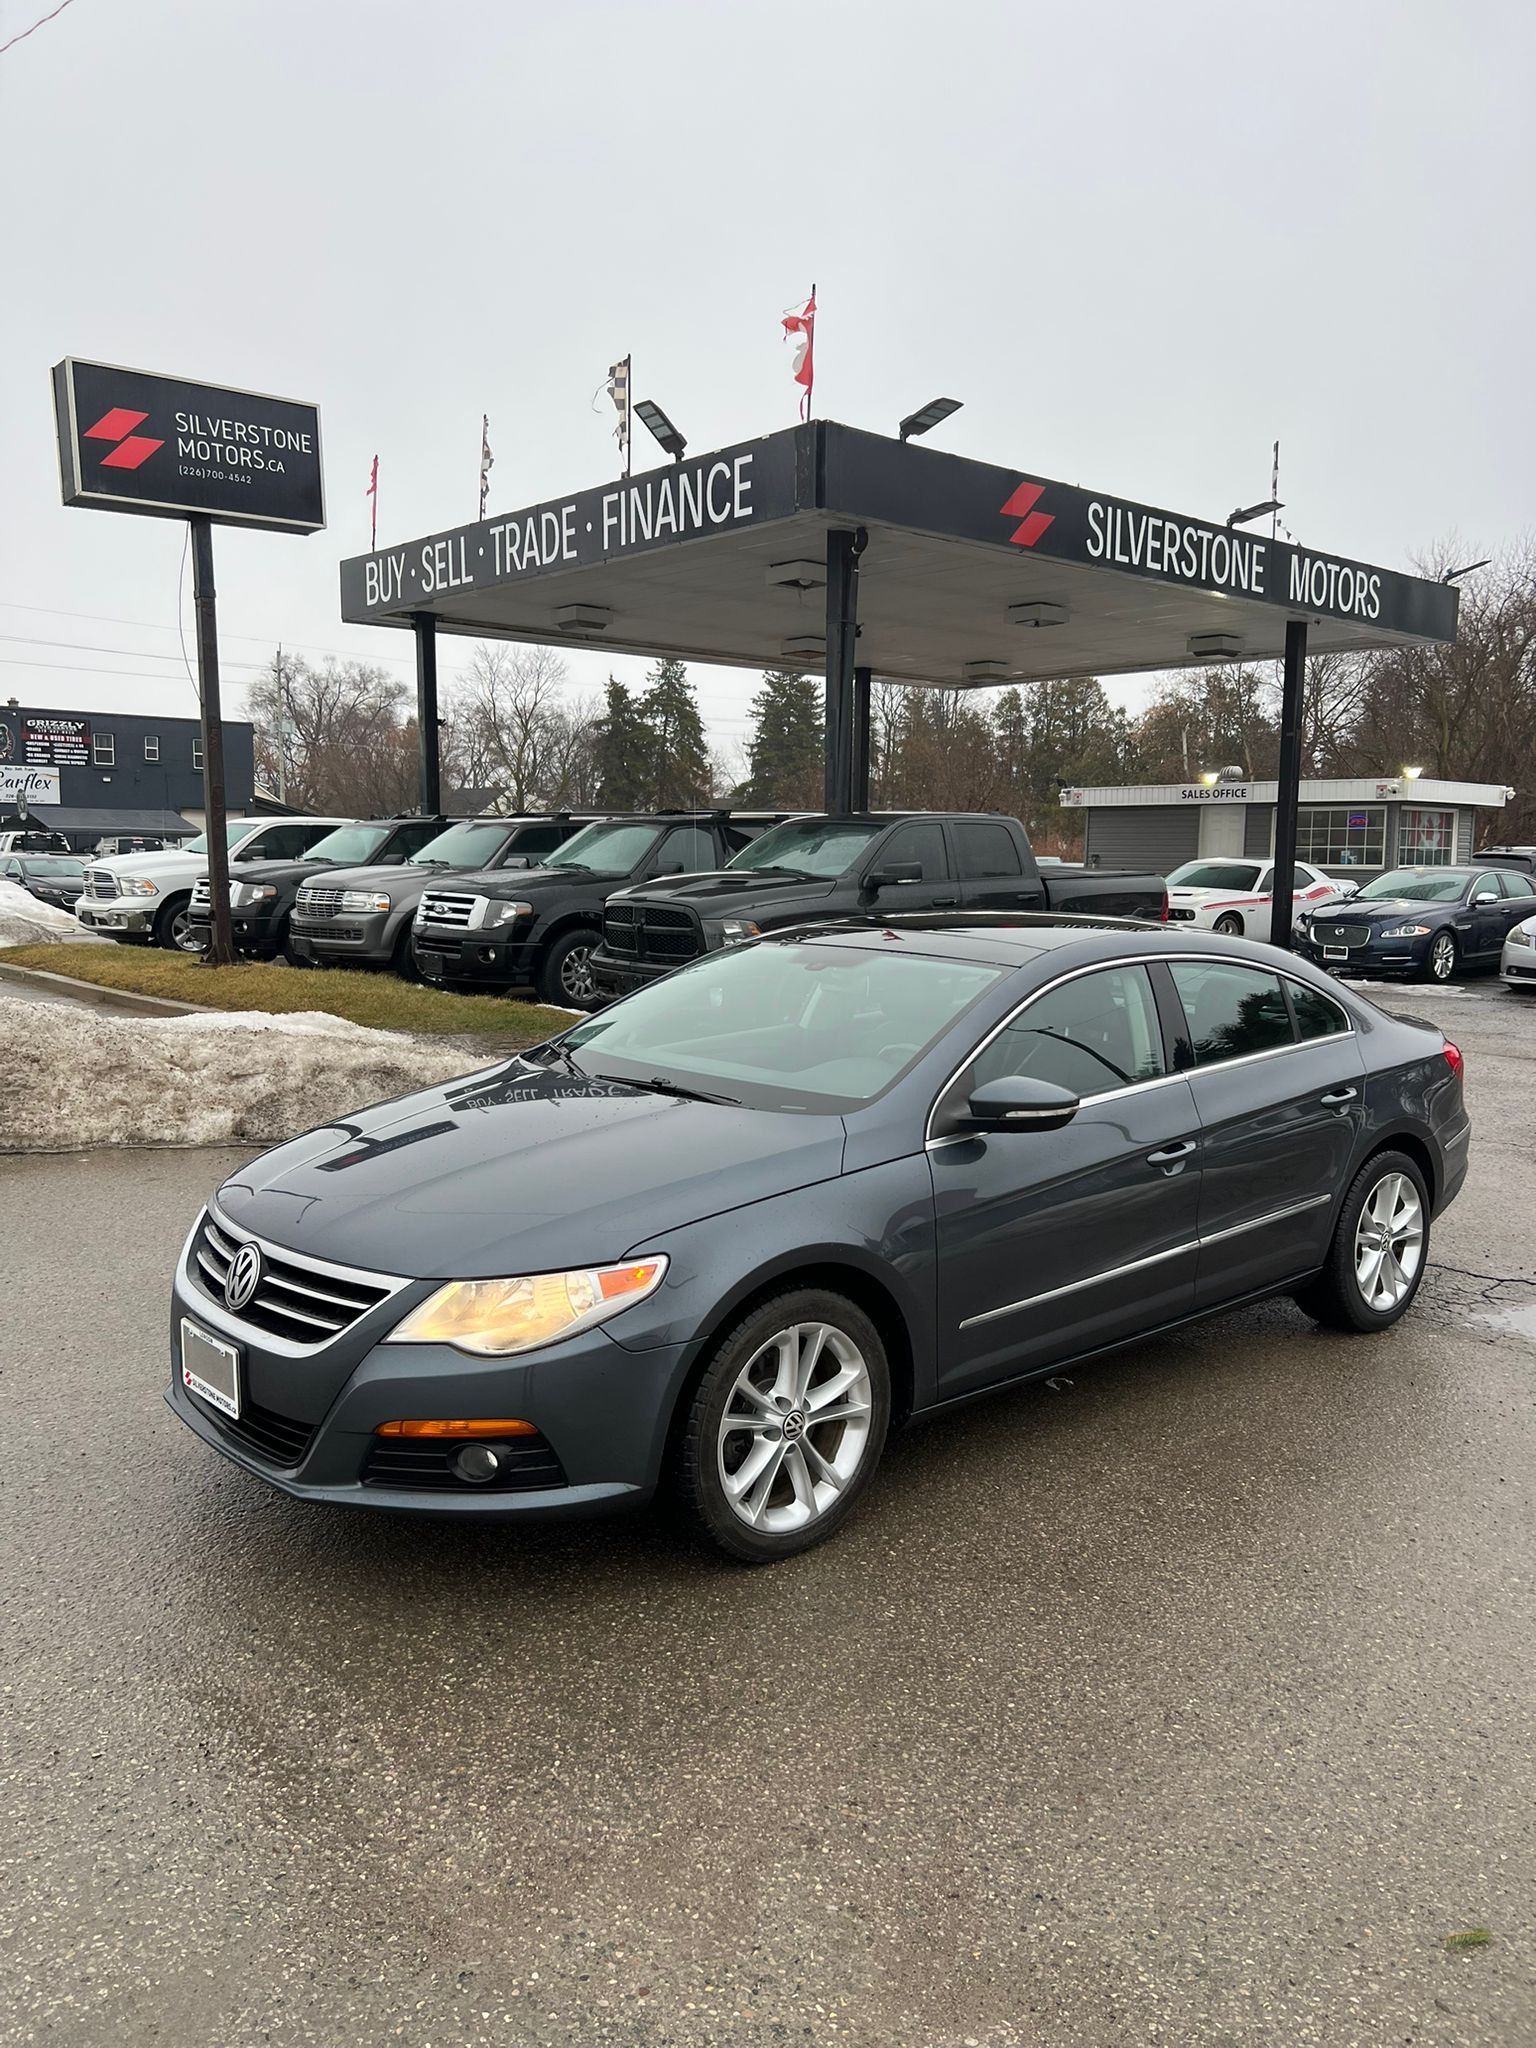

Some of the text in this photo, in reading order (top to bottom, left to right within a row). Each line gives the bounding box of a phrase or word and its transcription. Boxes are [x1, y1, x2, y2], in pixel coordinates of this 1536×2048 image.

[175, 412, 312, 453] SILVERSTONE
[178, 437, 285, 473] MOTORS.CA
[178, 465, 252, 484] (226)700-4542
[365, 454, 753, 606] BUY SELL TRADE FINANCE
[1086, 502, 1381, 619] SILVERSTONE MOTORS
[26, 719, 85, 730] GRIZZLY
[1181, 788, 1247, 799] SALES OFFICE
